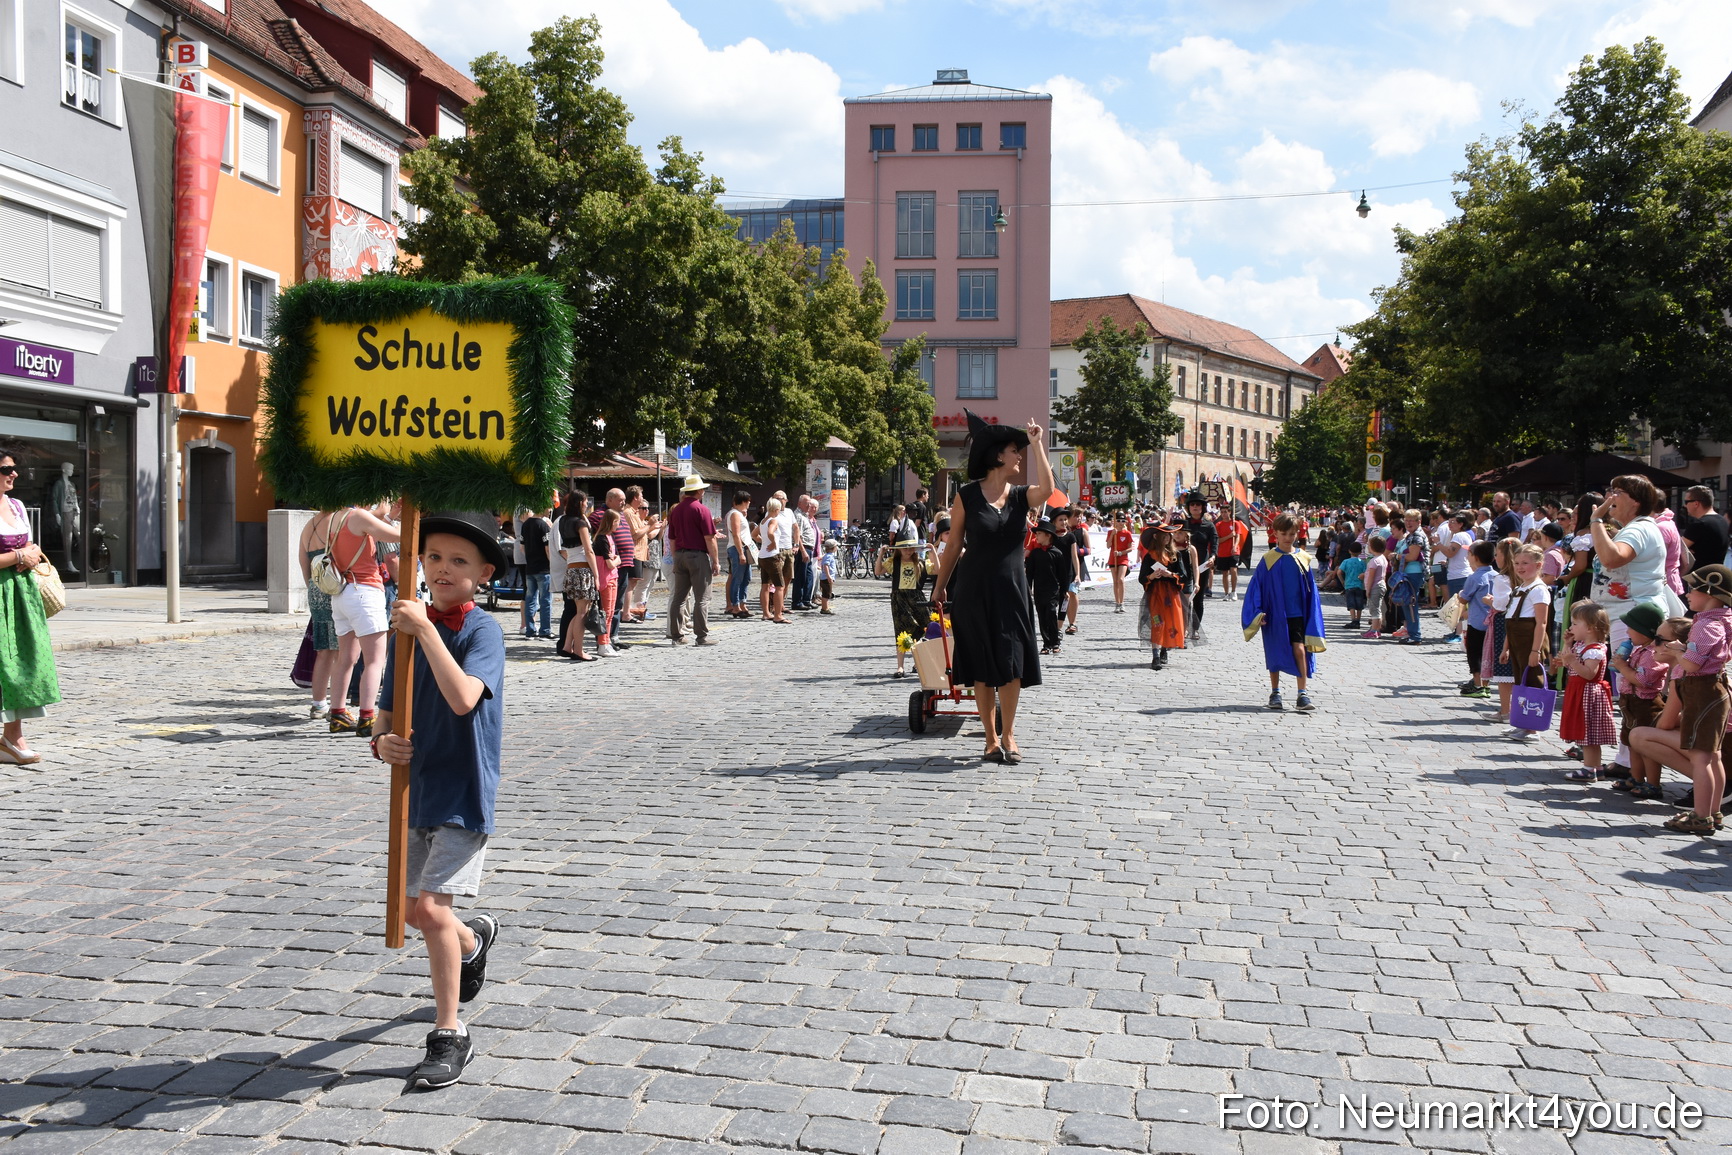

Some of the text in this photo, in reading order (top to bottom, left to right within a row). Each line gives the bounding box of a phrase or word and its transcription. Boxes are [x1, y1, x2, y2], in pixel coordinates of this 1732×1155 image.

[15, 344, 63, 378] liberty
[354, 325, 482, 372] Schule
[328, 394, 505, 441] Wolfstein
[1104, 485, 1125, 495] BSC
